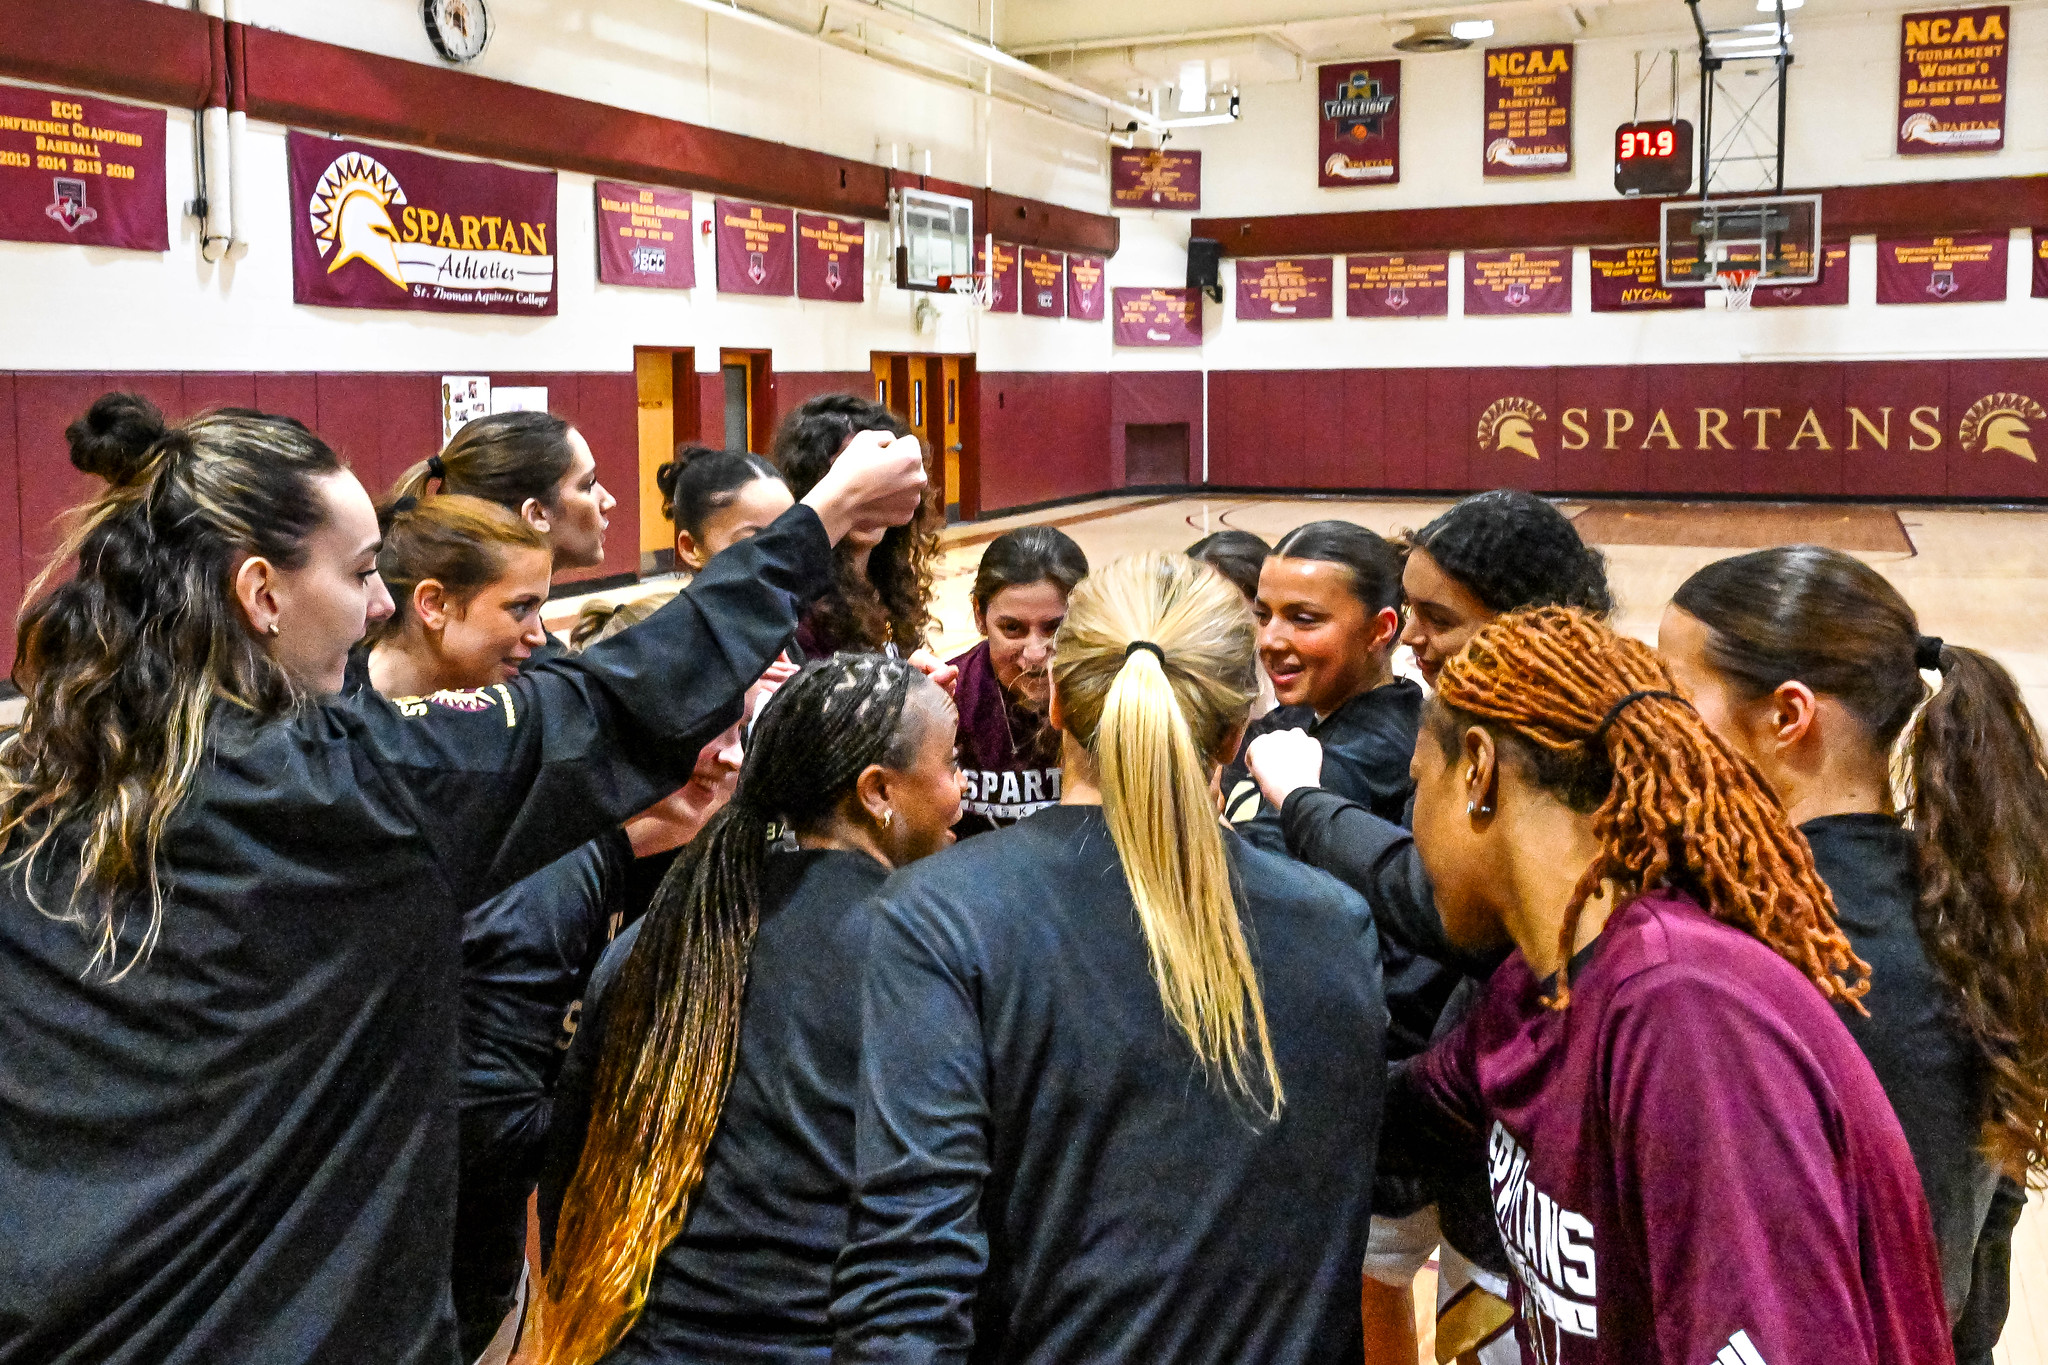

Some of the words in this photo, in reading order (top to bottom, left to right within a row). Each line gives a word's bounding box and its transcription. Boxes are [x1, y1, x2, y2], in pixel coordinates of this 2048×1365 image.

[1905, 15, 2005, 45] NCAA
[1488, 49, 1569, 77] NCAA
[1905, 44, 2003, 62] TOURNAMENT
[1919, 60, 1989, 77] WOMEN'S
[1499, 74, 1557, 87] TOURNAMENT
[1907, 77, 1999, 94] BASKETBALL
[51, 101, 82, 120] ECC
[1499, 96, 1557, 108] BASKETBALL
[0, 116, 69, 136] ONFERENCE
[36, 135, 101, 157] BASEBALL
[1621, 130, 1673, 158] 37.9
[402, 206, 546, 256] SPARTAN
[437, 253, 514, 282] Athletics
[413, 285, 430, 298] St.
[433, 286, 472, 303] Thomas
[516, 292, 548, 308] College
[1561, 406, 1942, 451] SPARTANS
[961, 767, 1061, 803] SPART
